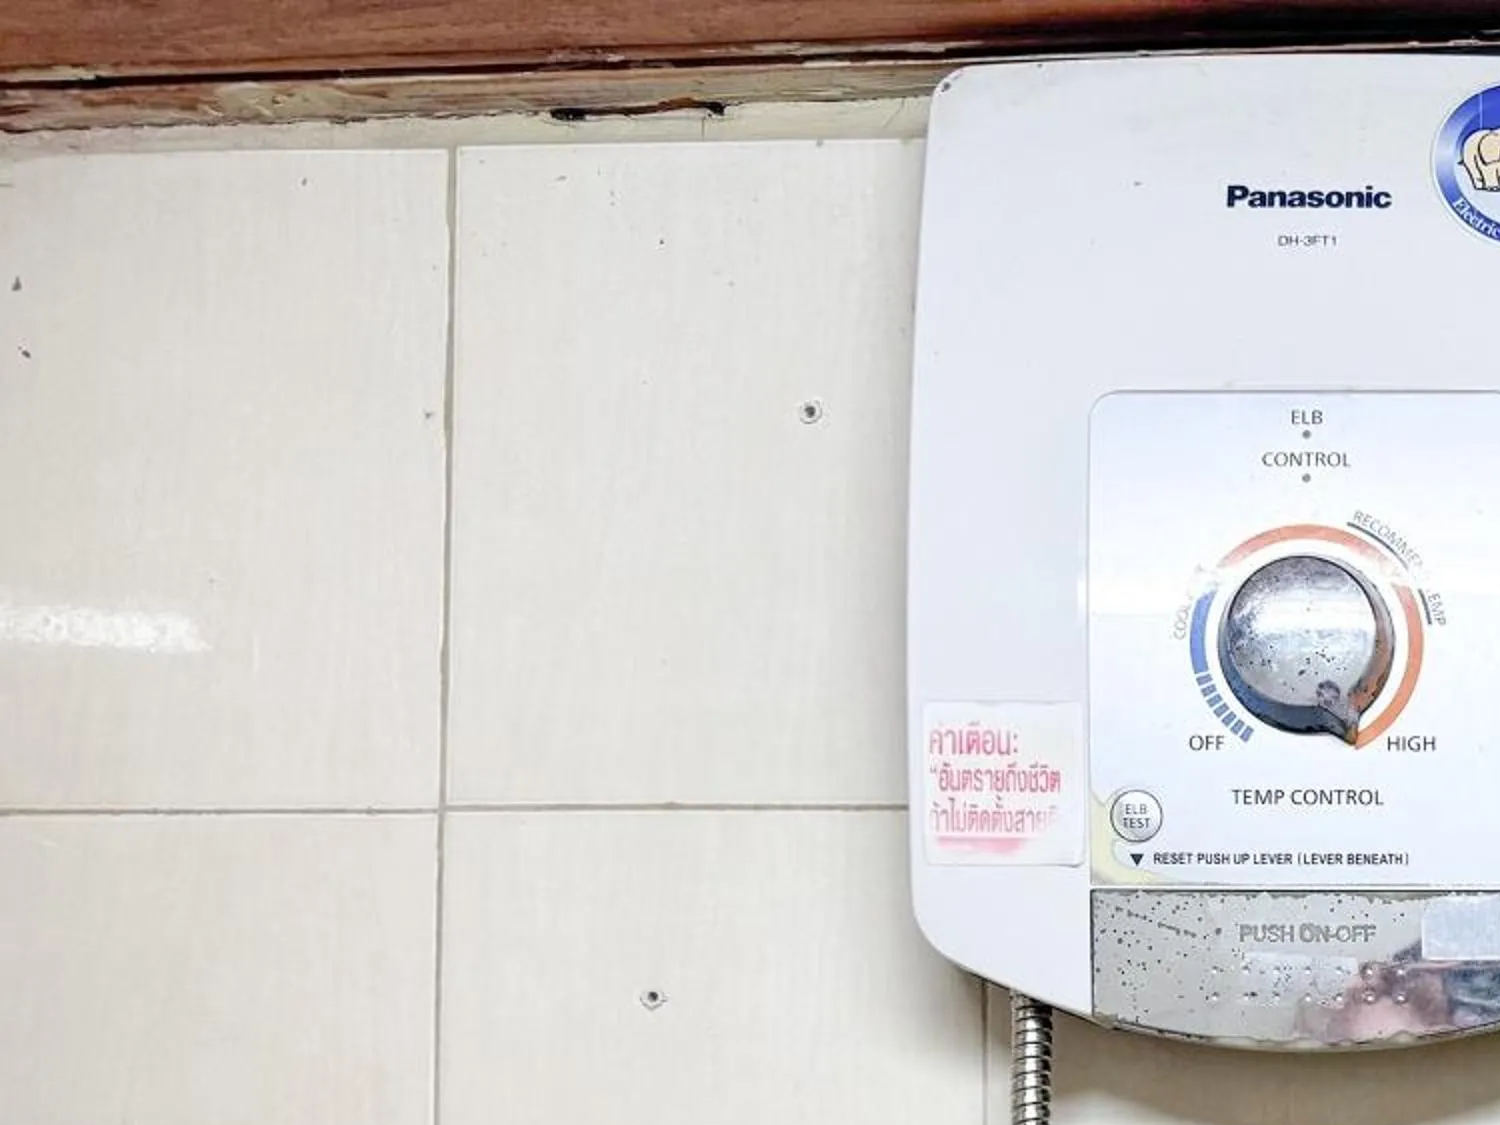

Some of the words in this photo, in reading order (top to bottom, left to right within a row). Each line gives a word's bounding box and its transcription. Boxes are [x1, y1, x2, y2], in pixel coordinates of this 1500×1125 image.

[1226, 184, 1393, 209] Panasonic
[1452, 198, 1500, 239] Electric
[1277, 234, 1338, 247] DH-3FT1
[1290, 409, 1324, 425] ELB
[1261, 451, 1351, 468] CONTROL
[1188, 734, 1226, 751] OFF
[1386, 735, 1438, 752] HIGH
[1232, 789, 1285, 805] TEMP
[1291, 789, 1385, 805] CONTROL
[1124, 803, 1148, 815] ELB
[1122, 817, 1152, 829] TEST
[1153, 852, 1193, 865] RESET
[1197, 852, 1231, 865] PUSH
[1233, 852, 1250, 865] UP
[1253, 852, 1293, 865] LEVER
[1297, 852, 1344, 866] (LEVER
[1347, 852, 1410, 866] BENEATH)
[1239, 924, 1295, 943] PUSH
[1299, 923, 1377, 943] ON-OFF
